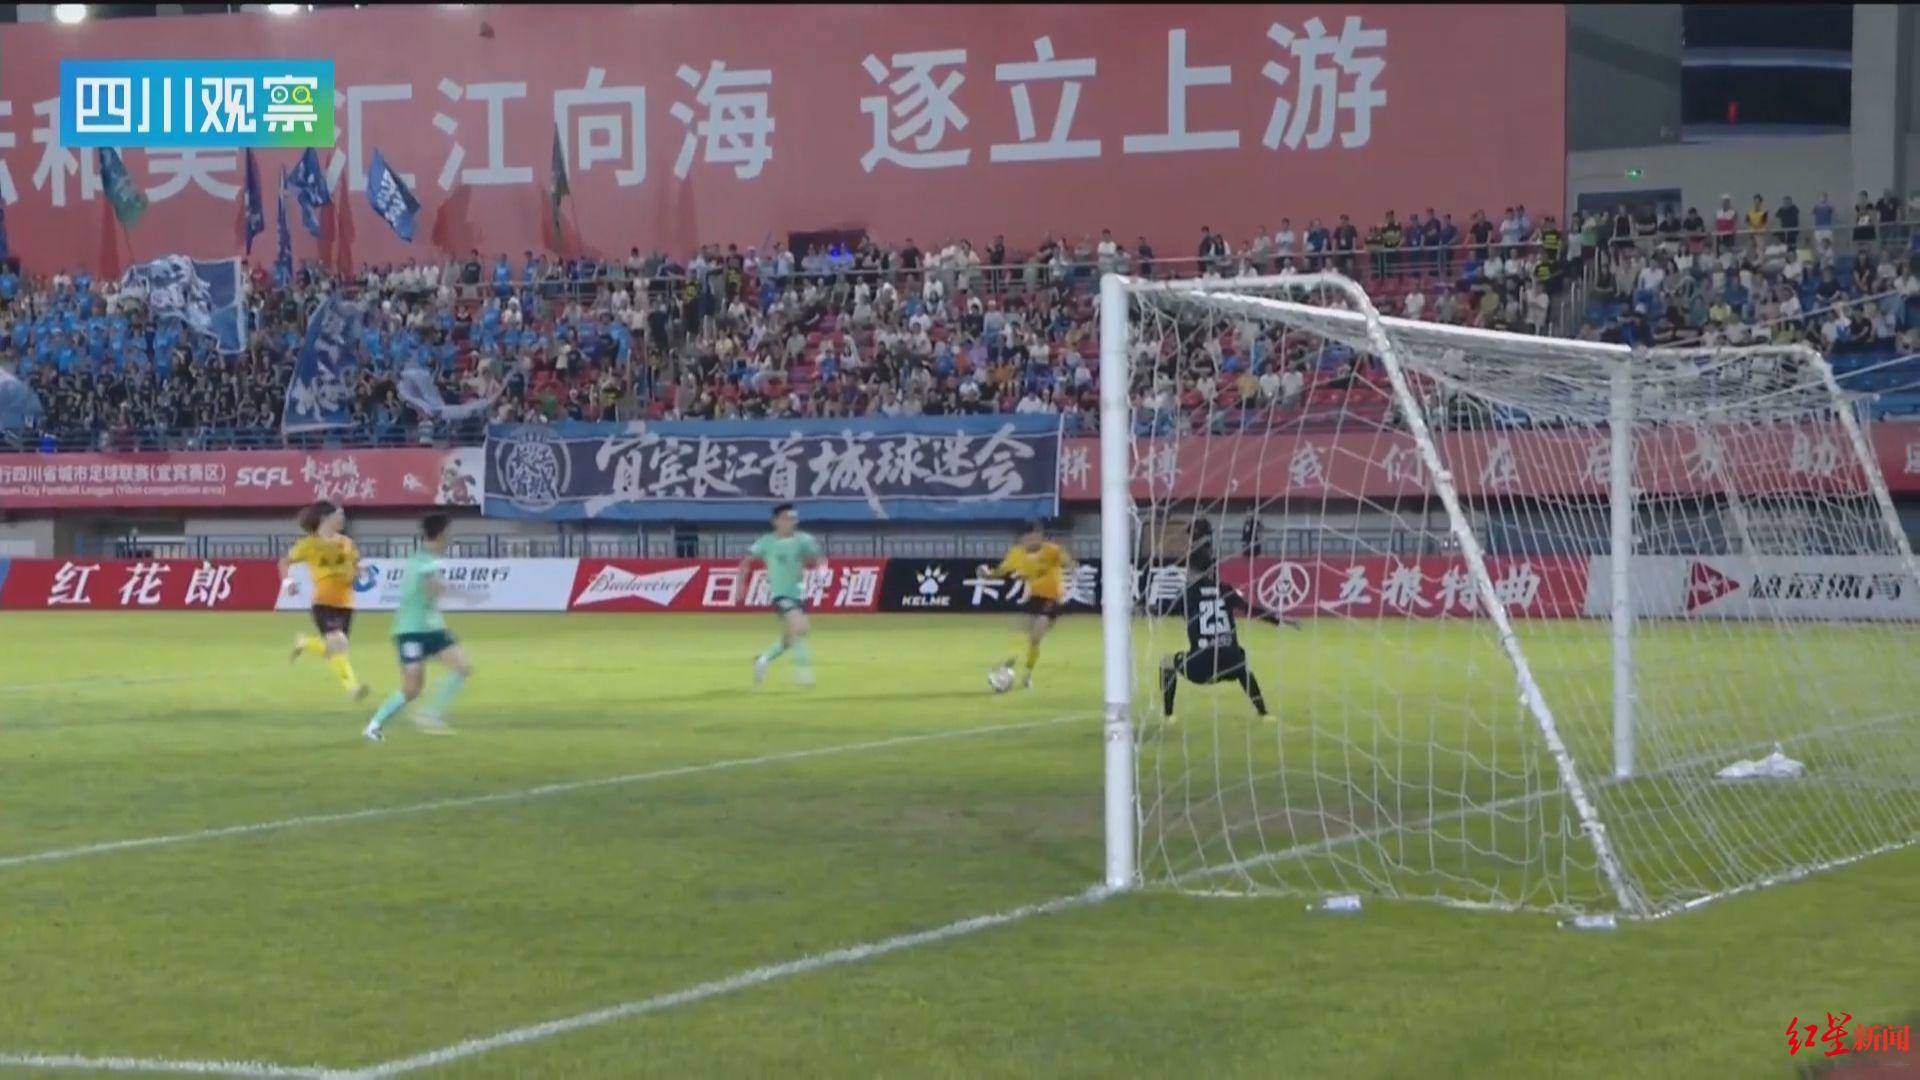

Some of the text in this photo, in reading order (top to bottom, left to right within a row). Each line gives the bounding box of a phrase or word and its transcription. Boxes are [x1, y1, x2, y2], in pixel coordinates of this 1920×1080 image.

[858, 15, 1389, 174] 逐立上游
[234, 466, 294, 489] SCFL
[584, 421, 1036, 518] 宜宾长江首城球迷会
[47, 561, 238, 606] 红花郎
[386, 565, 511, 582] 中设银行
[901, 596, 951, 607] KELME
[1199, 598, 1232, 635] 25
